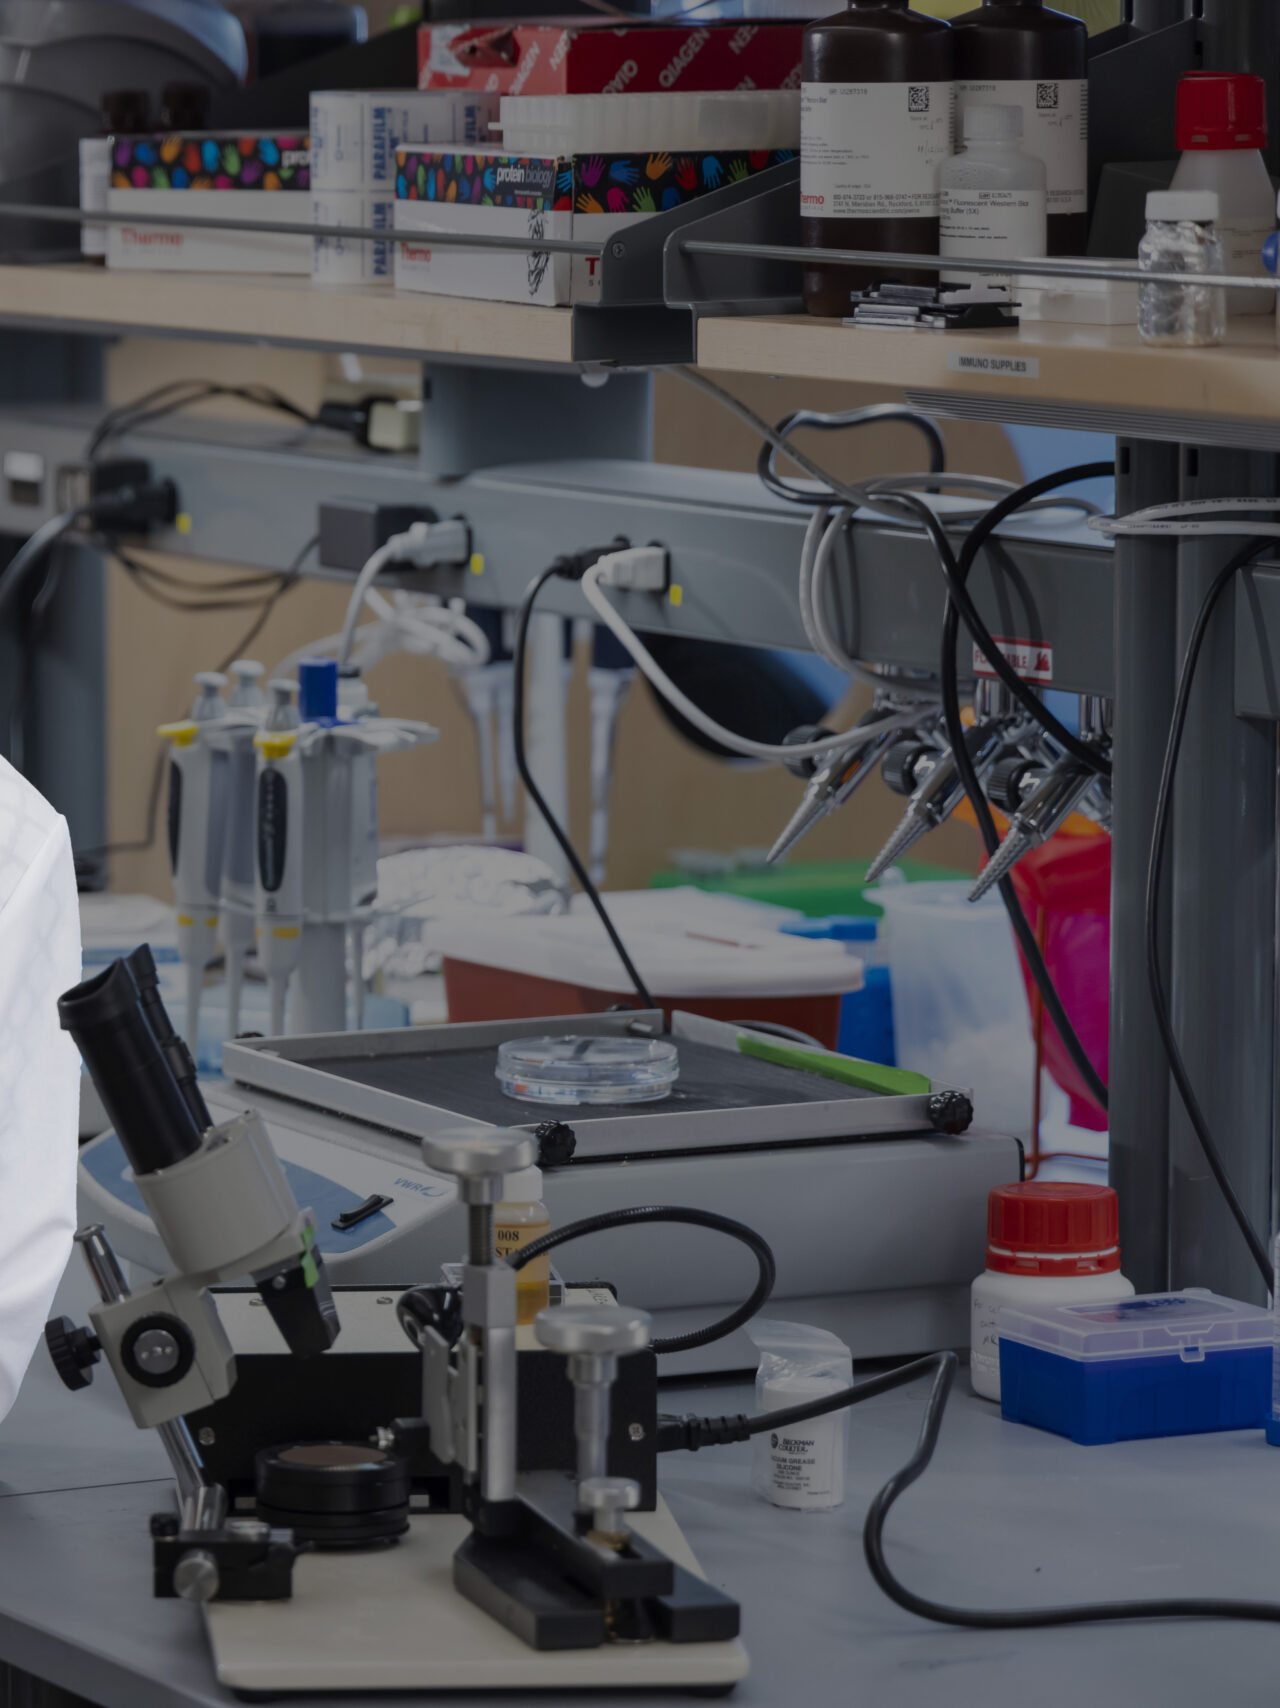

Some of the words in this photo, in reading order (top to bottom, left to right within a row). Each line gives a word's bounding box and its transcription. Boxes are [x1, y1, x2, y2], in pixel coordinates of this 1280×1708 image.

[658, 27, 711, 89] QIAGEN
[372, 107, 387, 181] PARAFILM
[496, 164, 525, 185] protein
[526, 165, 554, 188] biology
[121, 227, 183, 246] Thermo
[372, 203, 387, 276] PARAILM
[400, 241, 431, 263] Thermo
[959, 356, 988, 369] IMMUNO
[990, 359, 1027, 372] SUPPLIES
[974, 649, 1028, 669] FLABLE
[393, 1177, 424, 1192] VWR
[783, 1438, 815, 1447] BECKMAN
